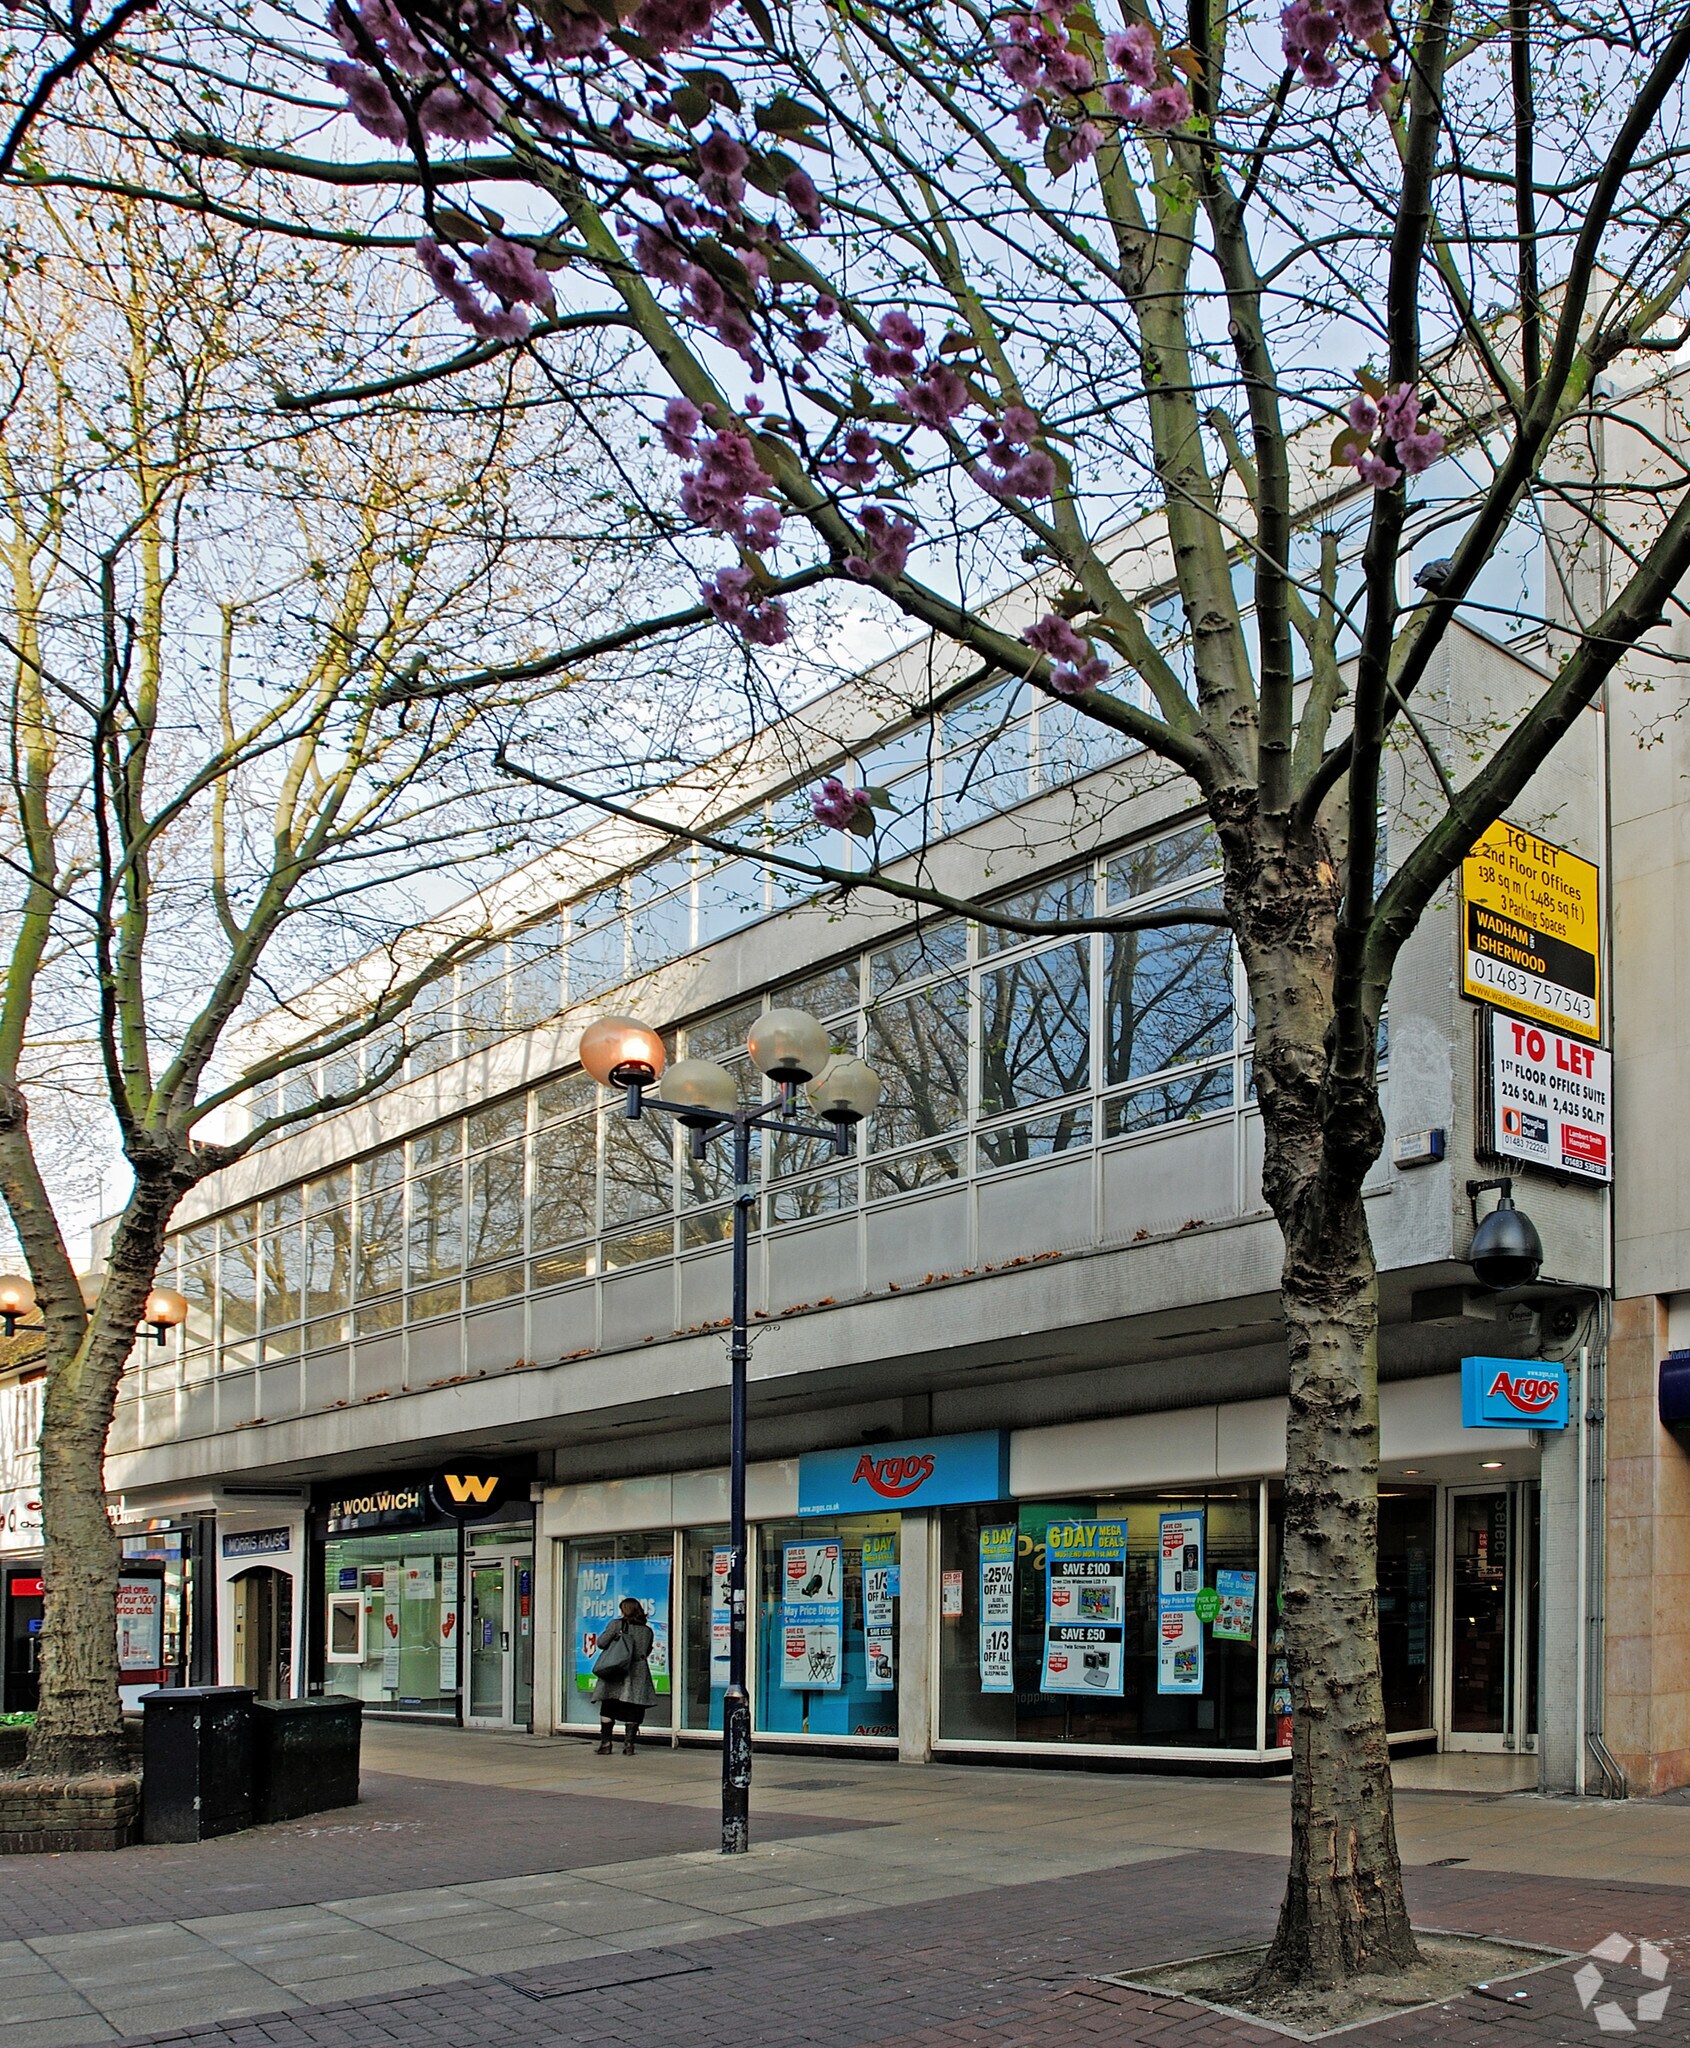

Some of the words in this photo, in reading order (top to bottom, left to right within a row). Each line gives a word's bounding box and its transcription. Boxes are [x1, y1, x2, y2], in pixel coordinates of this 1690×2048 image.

[1505, 827, 1526, 853] TO
[1533, 845, 1559, 868] LET
[1482, 842, 1505, 866] 2nd
[1509, 855, 1537, 881] Floor
[1542, 871, 1581, 900] Offices
[1478, 865, 1495, 882] 138
[1498, 874, 1510, 893] sq
[1513, 881, 1521, 894] m
[1557, 902, 1569, 917] sq
[1501, 894, 1507, 910] 3
[1509, 898, 1538, 927] Parking
[1540, 914, 1567, 936] Spaces
[1476, 910, 1529, 947] WADHAM
[1476, 933, 1546, 974] ISHERWOOD
[1474, 957, 1527, 995] 01483
[1533, 980, 1591, 1019] 757543
[1470, 983, 1594, 1036] www.wadhamandisherwood.co.uk
[1511, 1022, 1546, 1062] TO
[1556, 1038, 1595, 1079] LET
[1515, 1064, 1547, 1087] FLOOR
[1549, 1075, 1581, 1097] OFFICE
[1583, 1086, 1606, 1105] SUITE
[1502, 1082, 1520, 1098] 226
[1522, 1088, 1548, 1108] SQ.M
[1553, 1097, 1580, 1118] 2,435
[1582, 1106, 1605, 1125] SQ.FT
[1522, 1115, 1546, 1130] Douglas
[1505, 1135, 1524, 1148] 01483
[1569, 1129, 1589, 1141] Lambert
[1589, 1135, 1602, 1146] Smith
[1569, 1137, 1590, 1150] Hampton
[1487, 1371, 1560, 1413] Argos
[851, 1454, 936, 1498] Argos
[444, 1474, 499, 1503] W
[343, 1492, 419, 1516] WOOLWICH
[799, 1502, 840, 1514] www.argos.co.uk
[982, 1530, 990, 1546] 6
[992, 1528, 1013, 1545] DAY
[1049, 1526, 1061, 1548] 6
[1063, 1525, 1098, 1548] DAY
[1099, 1525, 1122, 1536] MEGA
[1494, 1500, 1507, 1558] Select
[228, 1536, 257, 1553] MORRIS
[258, 1532, 286, 1550] HOUSE
[864, 1539, 872, 1553] 6
[874, 1537, 893, 1553] DAY
[1099, 1537, 1125, 1548] DEALS
[988, 1566, 1012, 1583] 25%
[1062, 1563, 1085, 1575] SAVE
[1087, 1562, 1111, 1575] £100
[1218, 1571, 1232, 1580] May
[133, 1586, 149, 1594] one
[582, 1569, 609, 1595] May
[984, 1585, 998, 1595] OFF
[999, 1584, 1012, 1595] ALL
[1218, 1580, 1233, 1588] Price
[1236, 1581, 1254, 1591] Drops
[139, 1596, 157, 1604] 1000
[867, 1592, 879, 1602] OFF
[1160, 1597, 1171, 1605] May
[582, 1595, 614, 1618] Price
[784, 1606, 798, 1618] May
[800, 1605, 817, 1615] Price
[819, 1605, 840, 1617] Drops
[991, 1631, 1009, 1651] 1/3
[1060, 1627, 1085, 1640] SAVE
[1086, 1628, 1106, 1641] £50
[983, 1651, 997, 1662] OFF
[999, 1651, 1010, 1662] ALL
[854, 1724, 896, 1737] Argos
